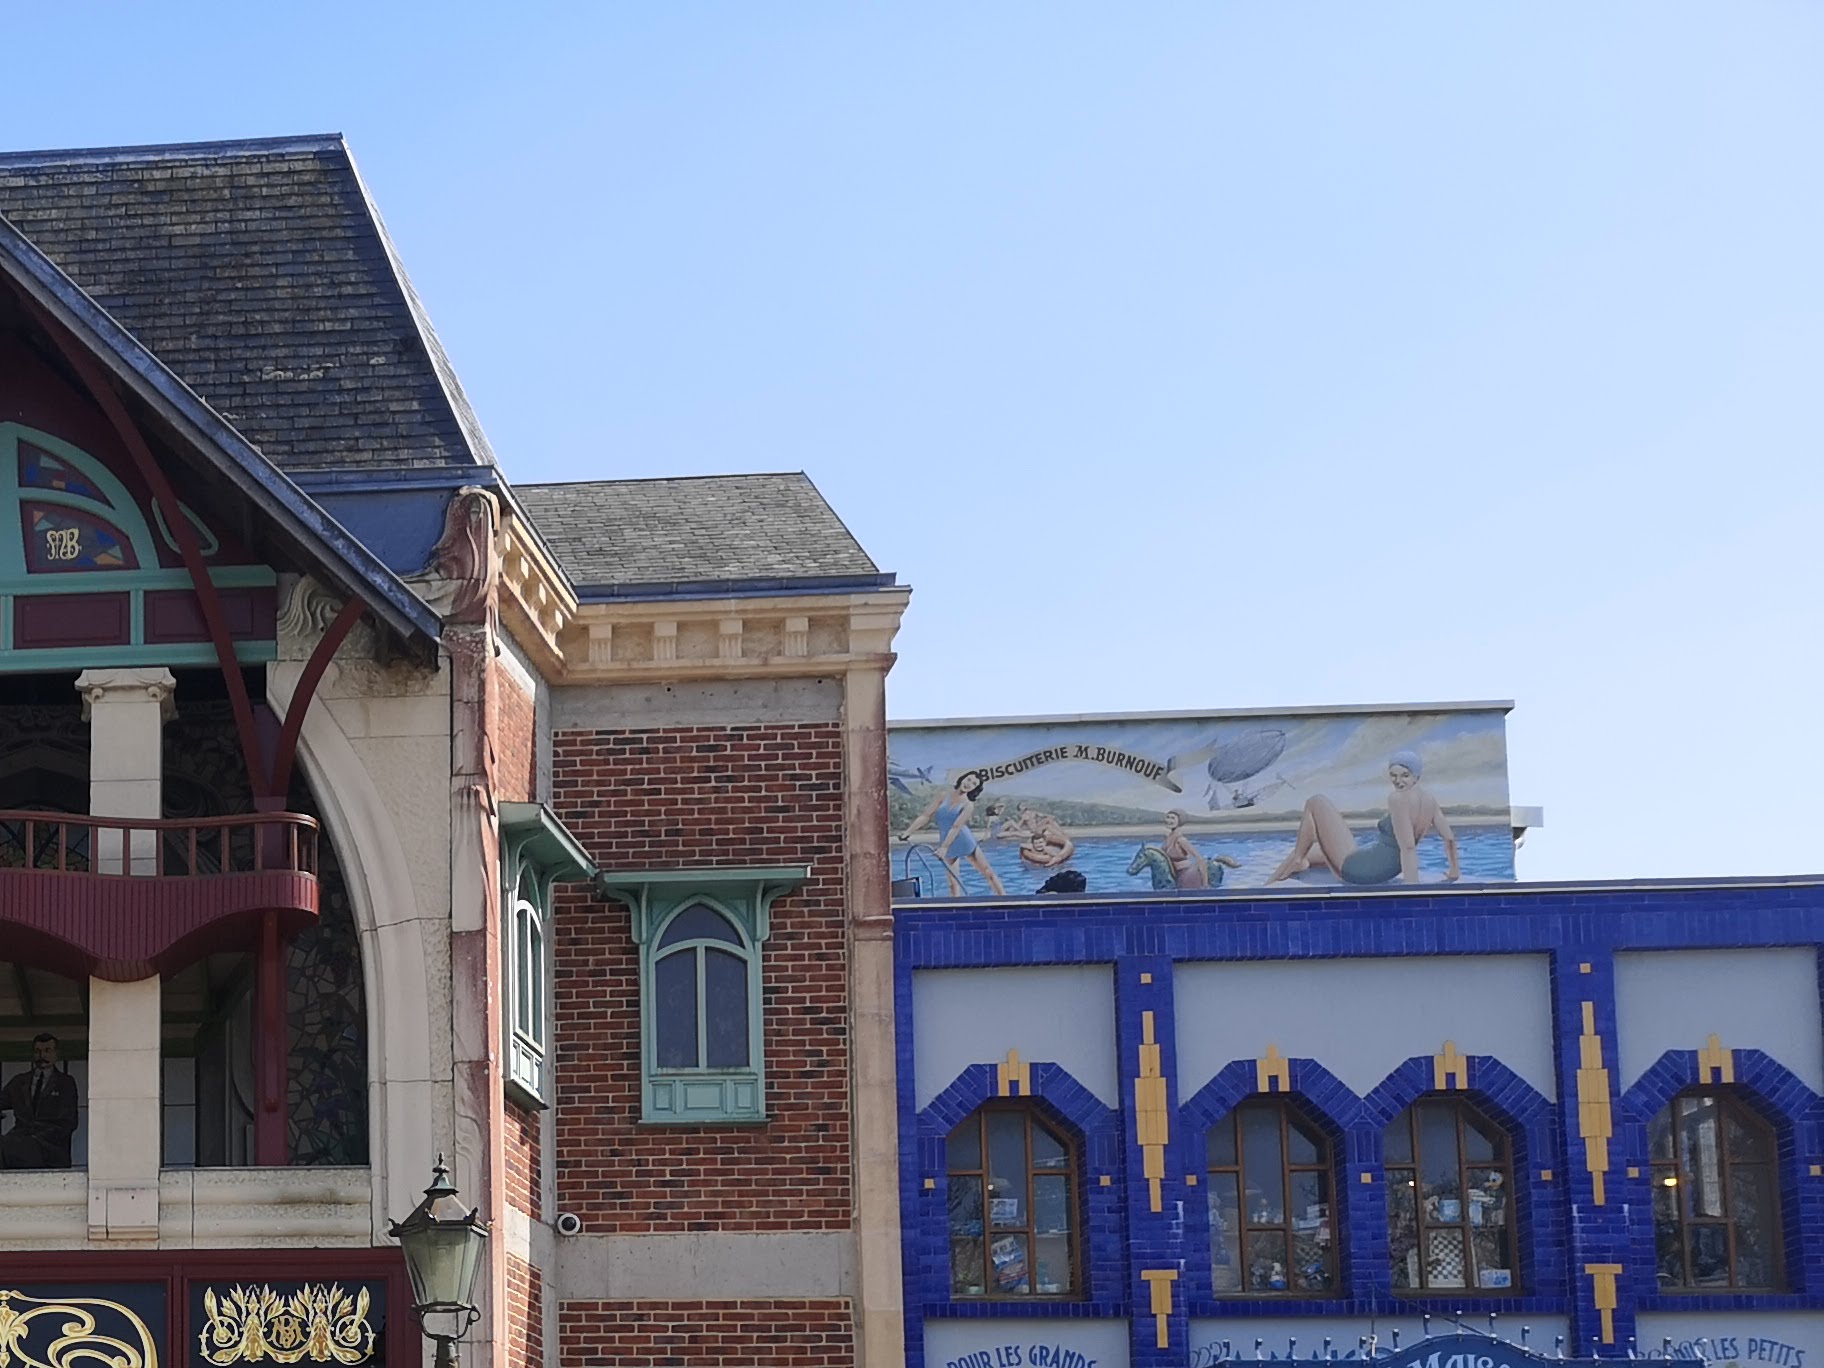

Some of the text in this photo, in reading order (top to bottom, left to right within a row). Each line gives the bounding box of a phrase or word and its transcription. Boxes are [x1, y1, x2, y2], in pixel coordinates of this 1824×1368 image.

[978, 746, 1068, 782] BISCUITERIE
[995, 1345, 1022, 1368] LES
[1711, 1338, 1739, 1361] LES
